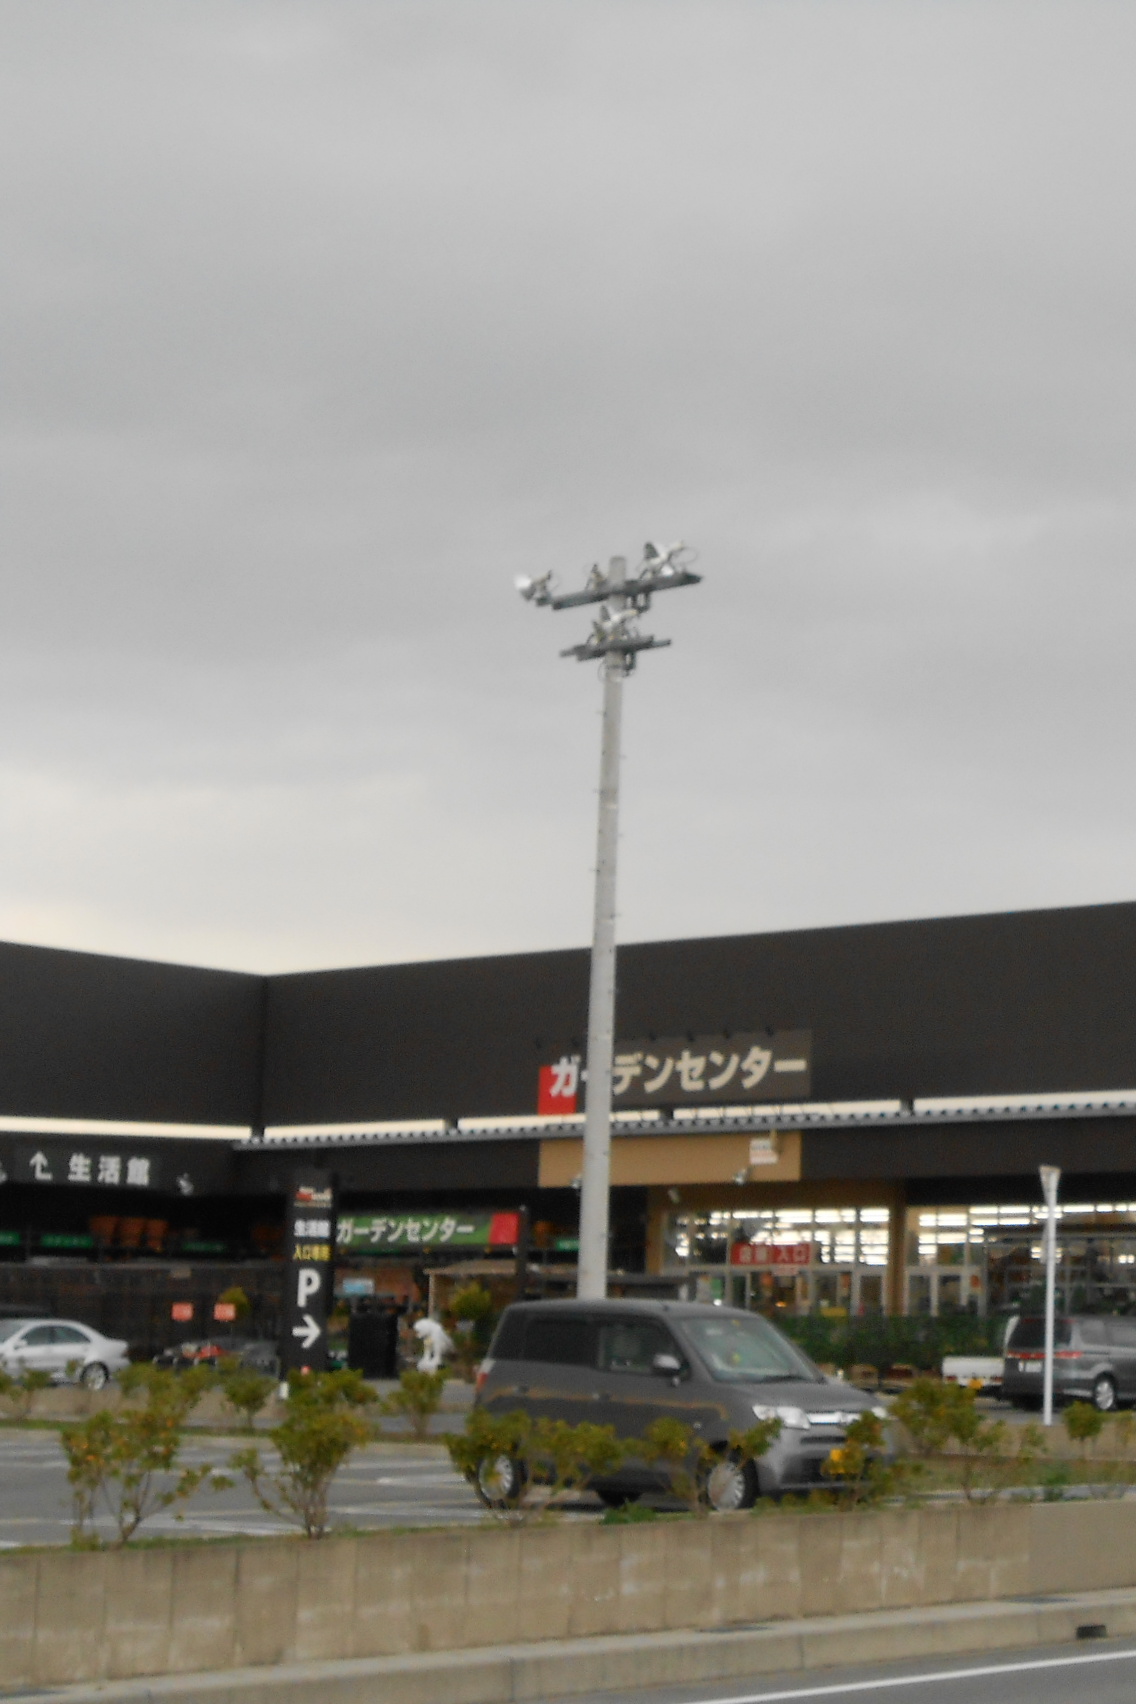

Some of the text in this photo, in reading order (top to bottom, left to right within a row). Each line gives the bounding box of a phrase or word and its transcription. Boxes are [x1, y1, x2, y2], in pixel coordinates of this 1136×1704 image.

[550, 1046, 807, 1097] ガデンセンター
[336, 1217, 475, 1244] ガーデンセンター
[297, 1268, 321, 1308] P
